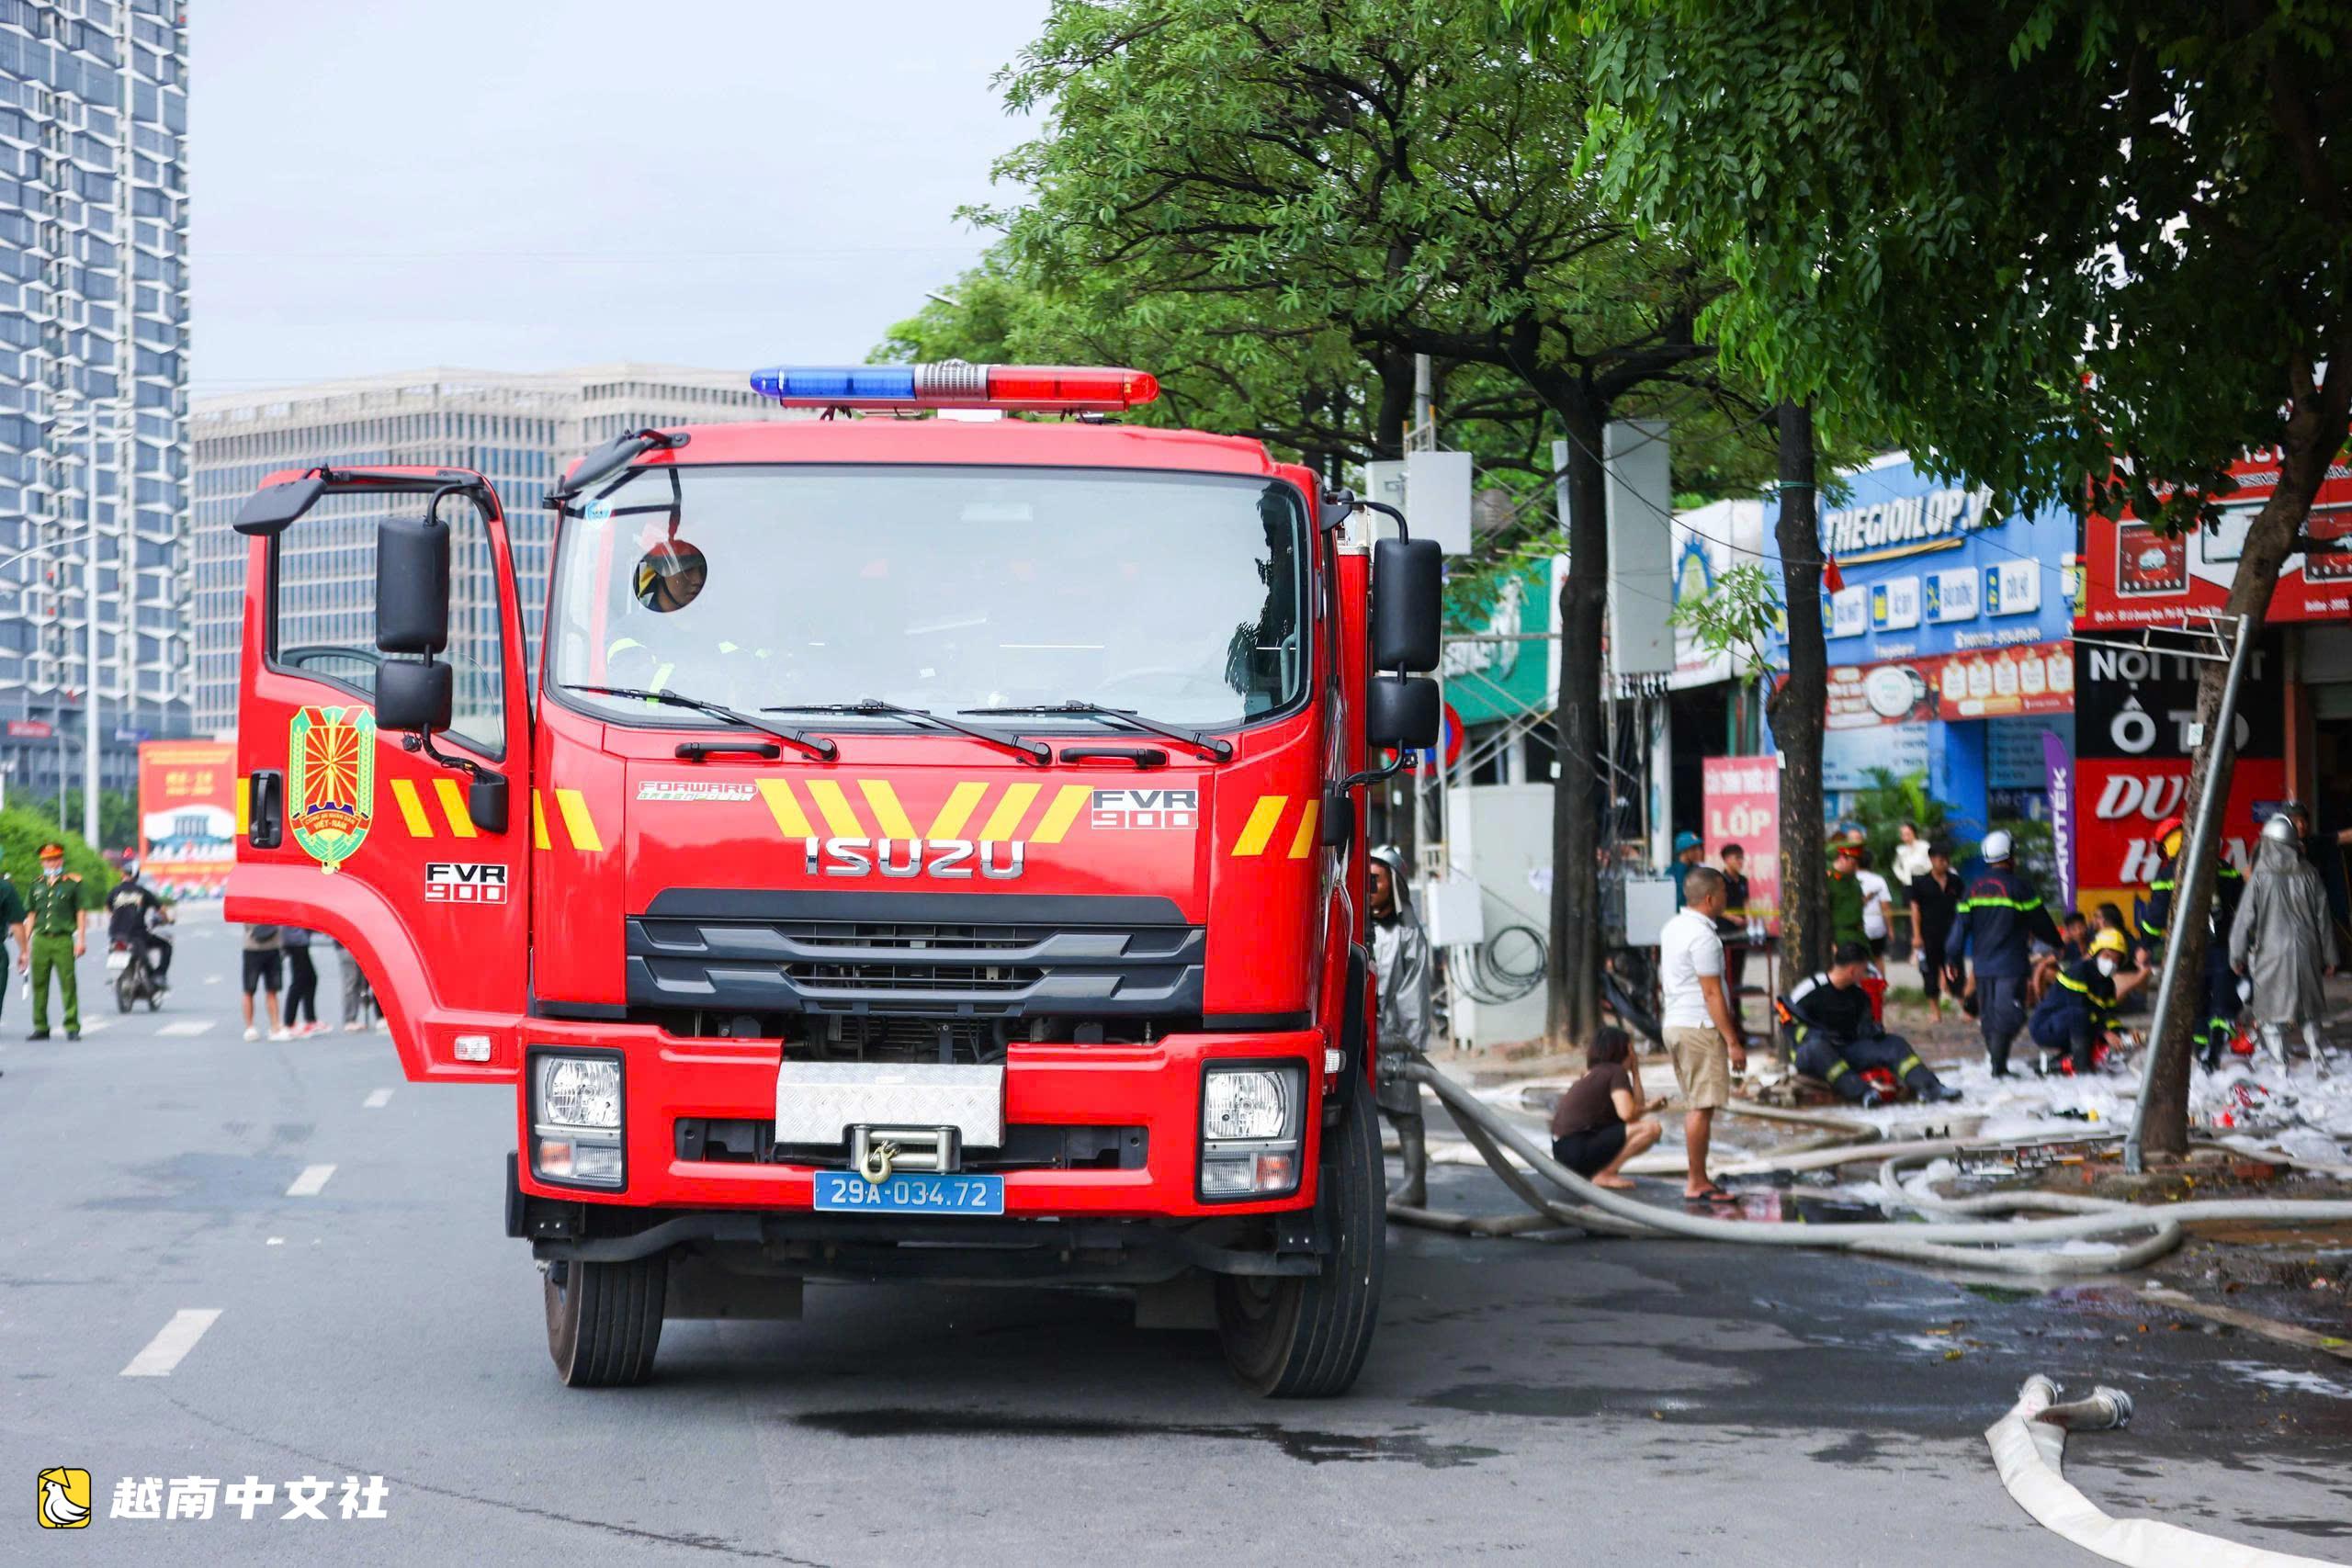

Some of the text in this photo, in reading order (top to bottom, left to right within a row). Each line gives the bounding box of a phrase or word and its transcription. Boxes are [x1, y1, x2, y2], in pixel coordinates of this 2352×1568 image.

[1823, 482, 2001, 554] THEGIOILOP.V
[2109, 694, 2157, 754] Ô
[639, 782, 757, 794] FORWARD
[1092, 790, 1197, 808] FVR
[1092, 810, 1197, 828] 900
[1712, 802, 1771, 838] LỐP
[806, 837, 1025, 879] ISUZU
[426, 864, 505, 883] FVR
[426, 884, 506, 902] 900
[831, 1179, 987, 1207] 29A-034.72
